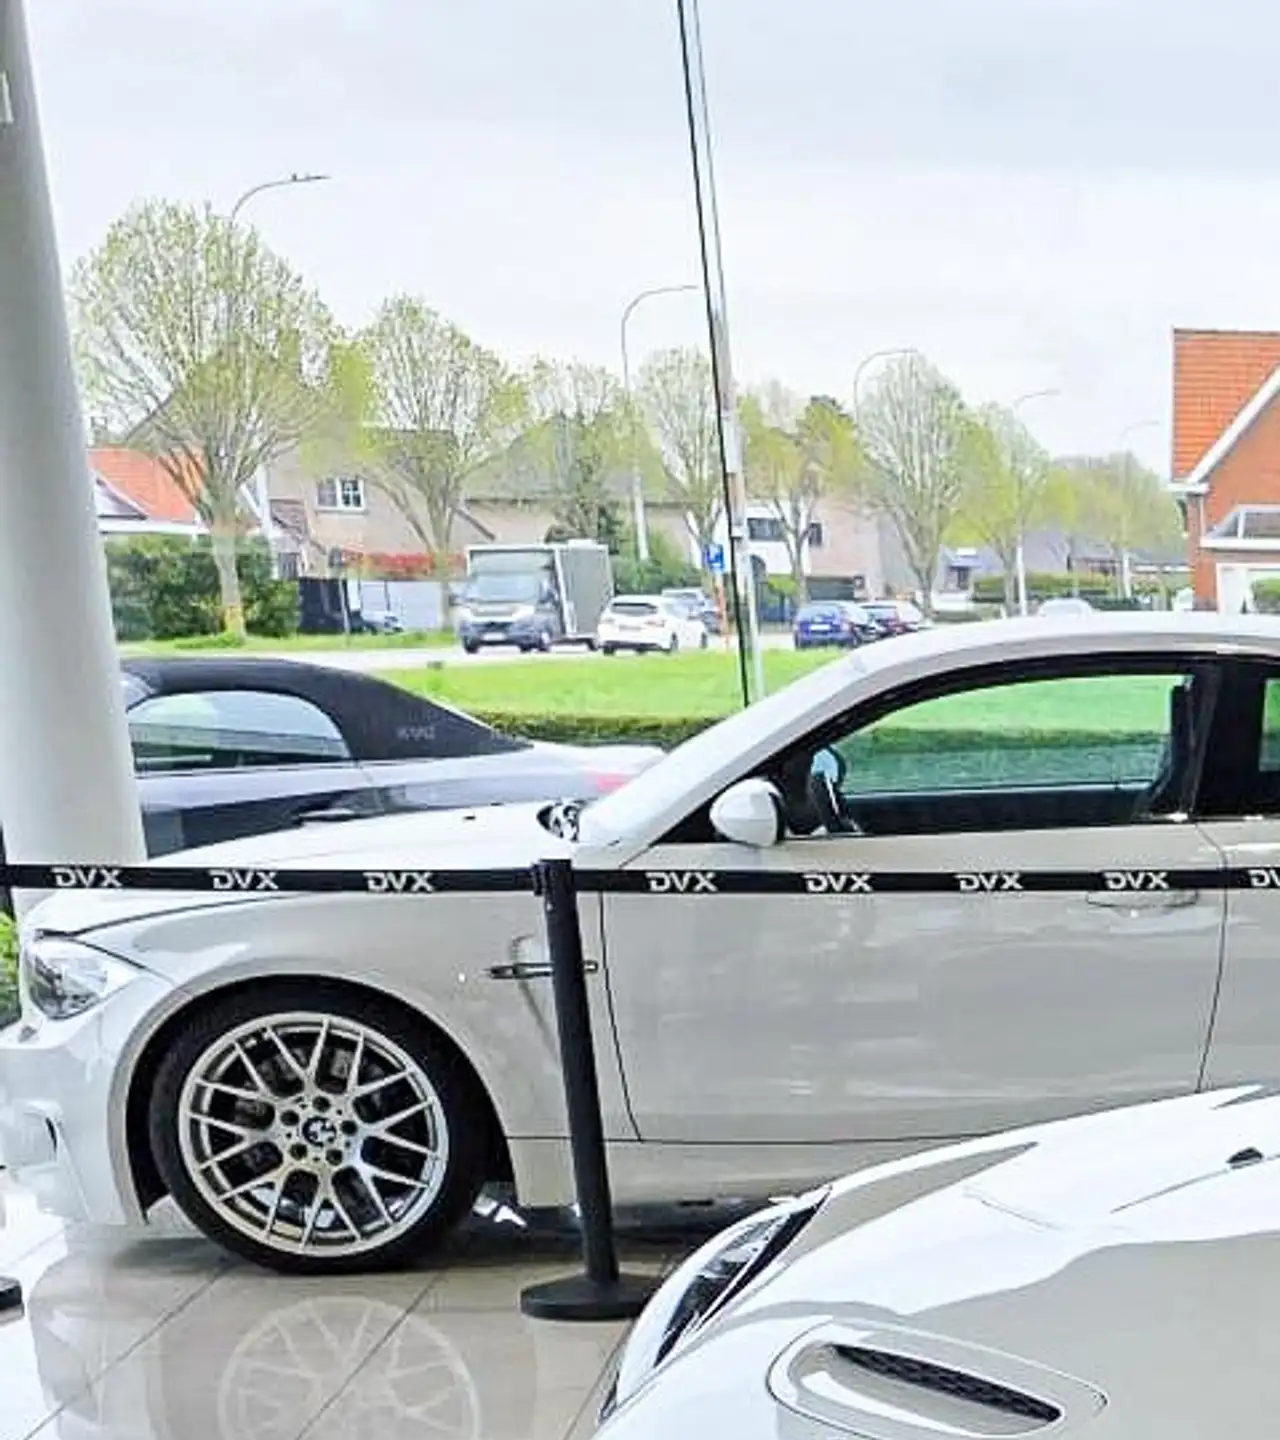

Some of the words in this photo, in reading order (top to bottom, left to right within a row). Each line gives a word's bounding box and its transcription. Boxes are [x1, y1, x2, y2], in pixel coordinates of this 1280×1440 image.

[51, 867, 122, 888] DVX
[209, 868, 279, 889] DVX
[362, 871, 433, 892] DVX
[645, 872, 718, 892] DVX
[802, 873, 873, 892] DVX
[955, 872, 1023, 890] DVX
[1104, 871, 1169, 889] DVX
